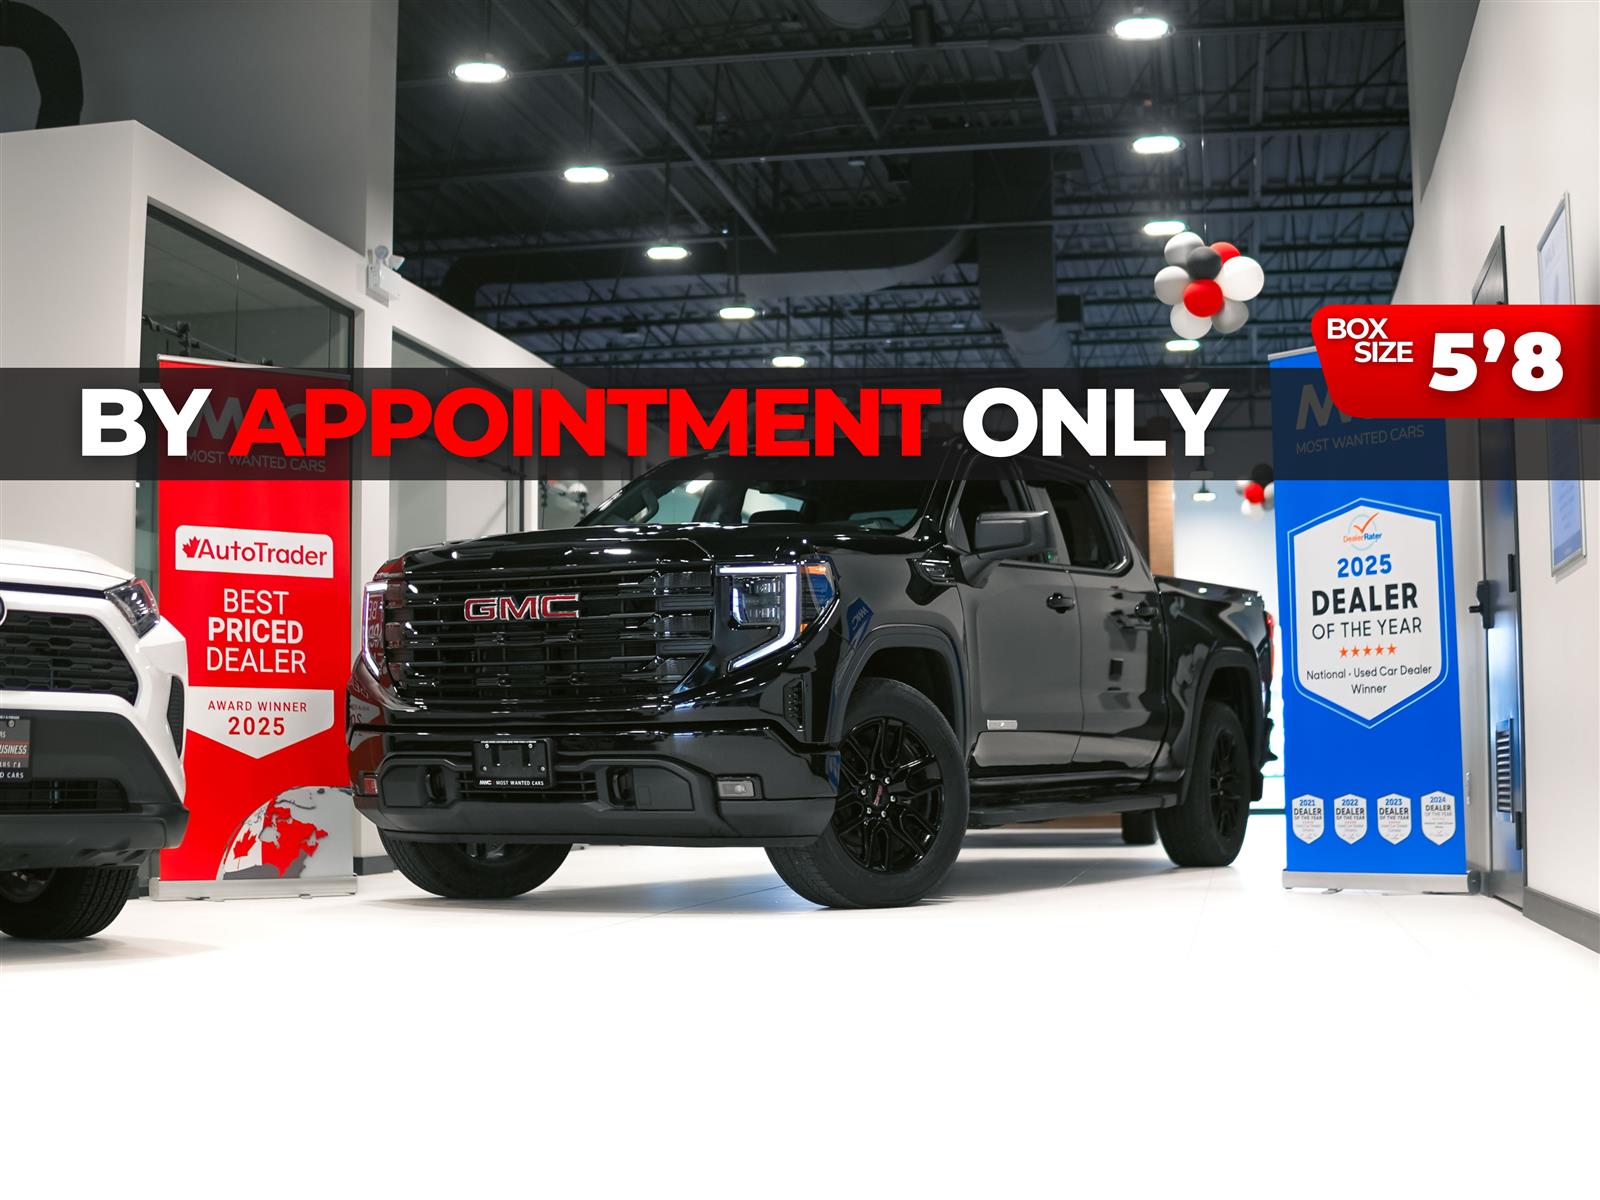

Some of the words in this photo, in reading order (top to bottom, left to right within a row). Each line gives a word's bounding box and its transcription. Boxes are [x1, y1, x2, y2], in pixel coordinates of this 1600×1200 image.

[1296, 438, 1329, 455] MOST
[1332, 430, 1387, 449] WANTED
[1390, 424, 1425, 441] CARS
[185, 450, 224, 465] MOST
[228, 454, 287, 470] WANTED
[289, 458, 327, 473] CARS
[197, 538, 328, 566] AutoTrader
[1337, 554, 1392, 578] 2025
[223, 588, 290, 615] BEST
[463, 593, 579, 622] GMC
[1312, 582, 1418, 617] DEALER
[208, 616, 304, 645] PRICED
[1312, 622, 1335, 640] OF
[1341, 620, 1371, 638] THE
[1377, 616, 1422, 635] YEAR
[206, 646, 307, 674] DEALER
[1306, 668, 1346, 681] National
[1353, 667, 1377, 678] Used
[1379, 666, 1397, 677] Car
[1400, 664, 1432, 675] Dealer
[1351, 684, 1388, 694] Winner
[207, 700, 253, 711] AWARD
[257, 700, 308, 712] WINNER
[228, 716, 286, 736] 2025
[1379, 807, 1409, 815] DEALER
